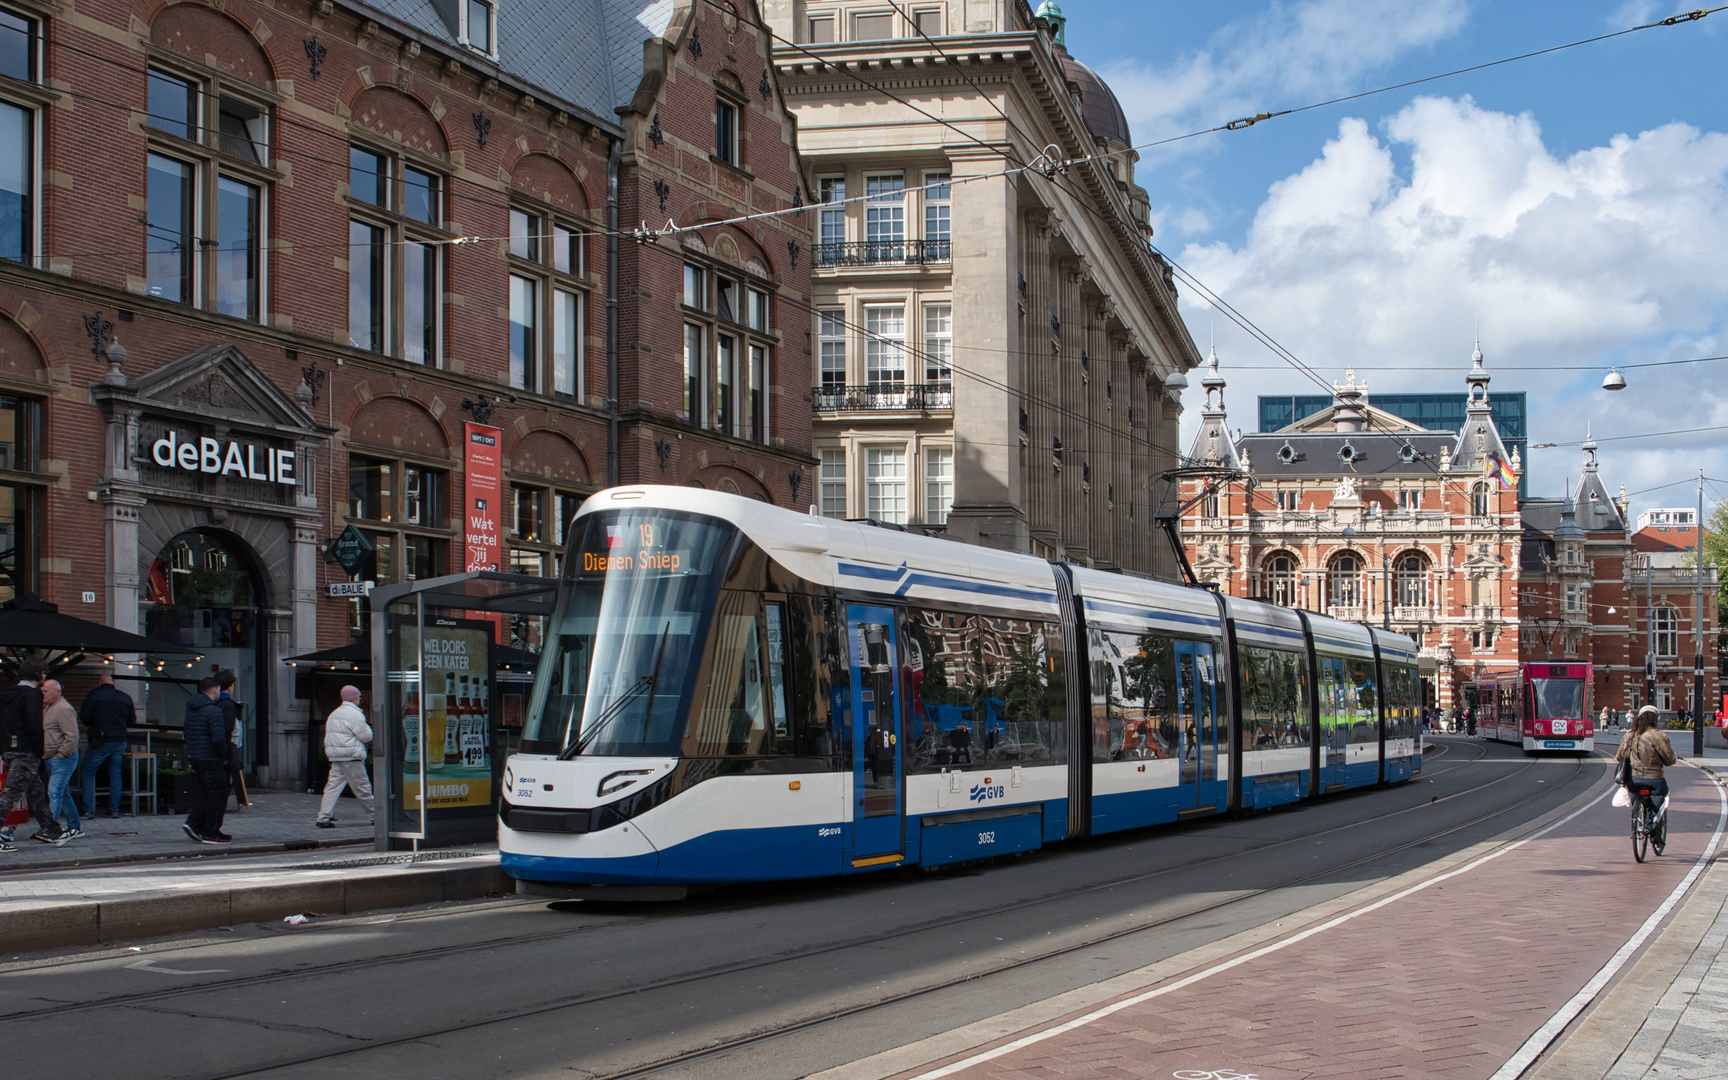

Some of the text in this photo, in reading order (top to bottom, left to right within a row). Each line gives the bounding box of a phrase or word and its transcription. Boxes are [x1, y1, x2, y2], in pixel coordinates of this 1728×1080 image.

[152, 430, 296, 484] deBALIE
[471, 516, 493, 530] Wat
[467, 534, 496, 546] vertel
[639, 524, 653, 547] 19
[476, 548, 486, 562] jij
[584, 551, 680, 572] Diemen Sniep
[332, 585, 364, 594] dBALIE
[424, 639, 466, 654] WEL DORS
[445, 655, 470, 670] KATER
[427, 784, 469, 797] JUMBO
[518, 789, 533, 797] 3052
[987, 786, 1004, 799] GVB
[978, 831, 995, 844] 3052
